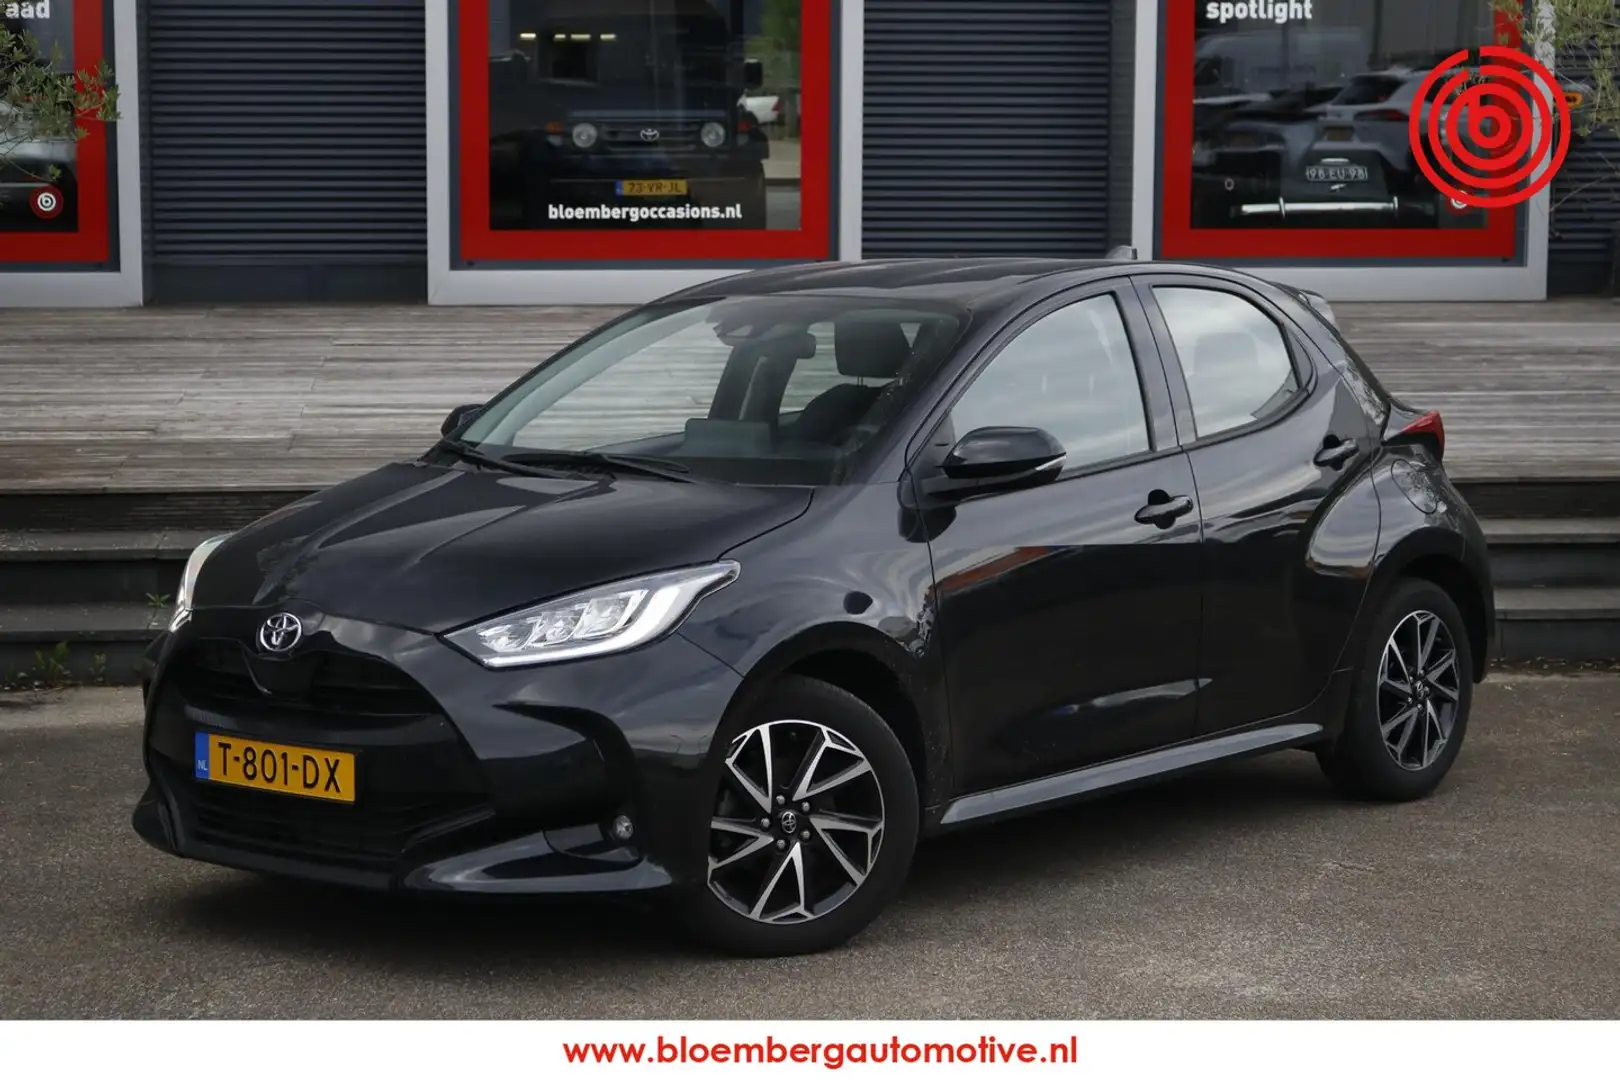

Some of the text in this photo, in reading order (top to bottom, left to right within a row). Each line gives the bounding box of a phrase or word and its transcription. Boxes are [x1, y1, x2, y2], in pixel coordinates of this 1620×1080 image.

[0, 0, 50, 19] aad
[1205, 0, 1313, 24] spotlight
[548, 203, 743, 222] bloembergoccasions.nl
[197, 759, 208, 771] NL
[218, 742, 341, 793] T-801-DX
